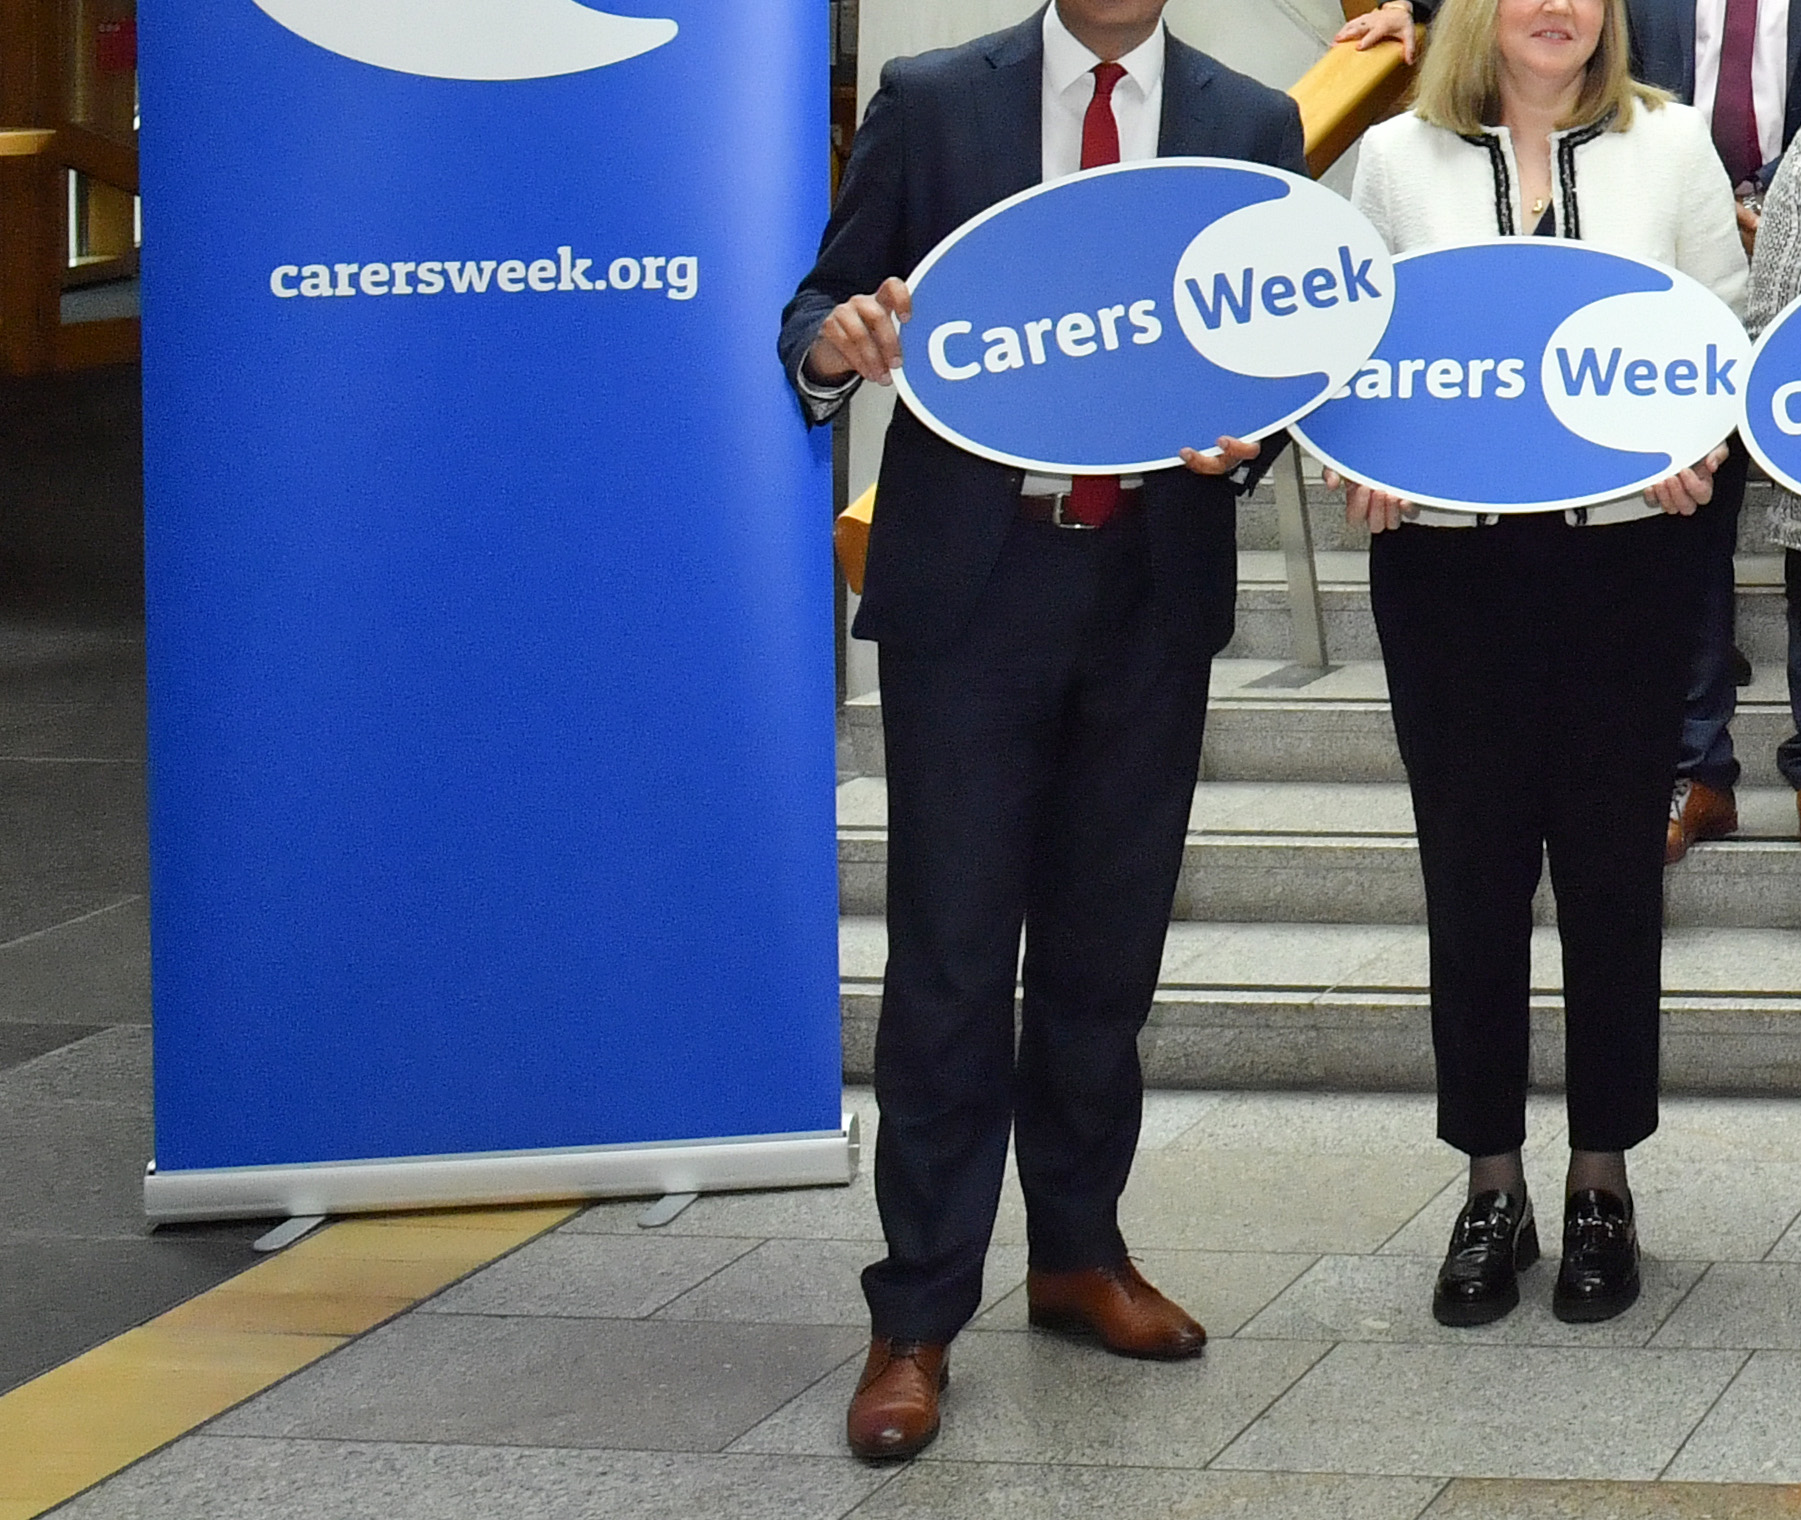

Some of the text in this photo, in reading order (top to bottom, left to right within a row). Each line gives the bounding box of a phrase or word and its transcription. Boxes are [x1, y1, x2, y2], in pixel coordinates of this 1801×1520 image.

[270, 246, 698, 300] carersweek.org
[928, 245, 1382, 381] Carers Week
[1331, 343, 1737, 399] arers Week
